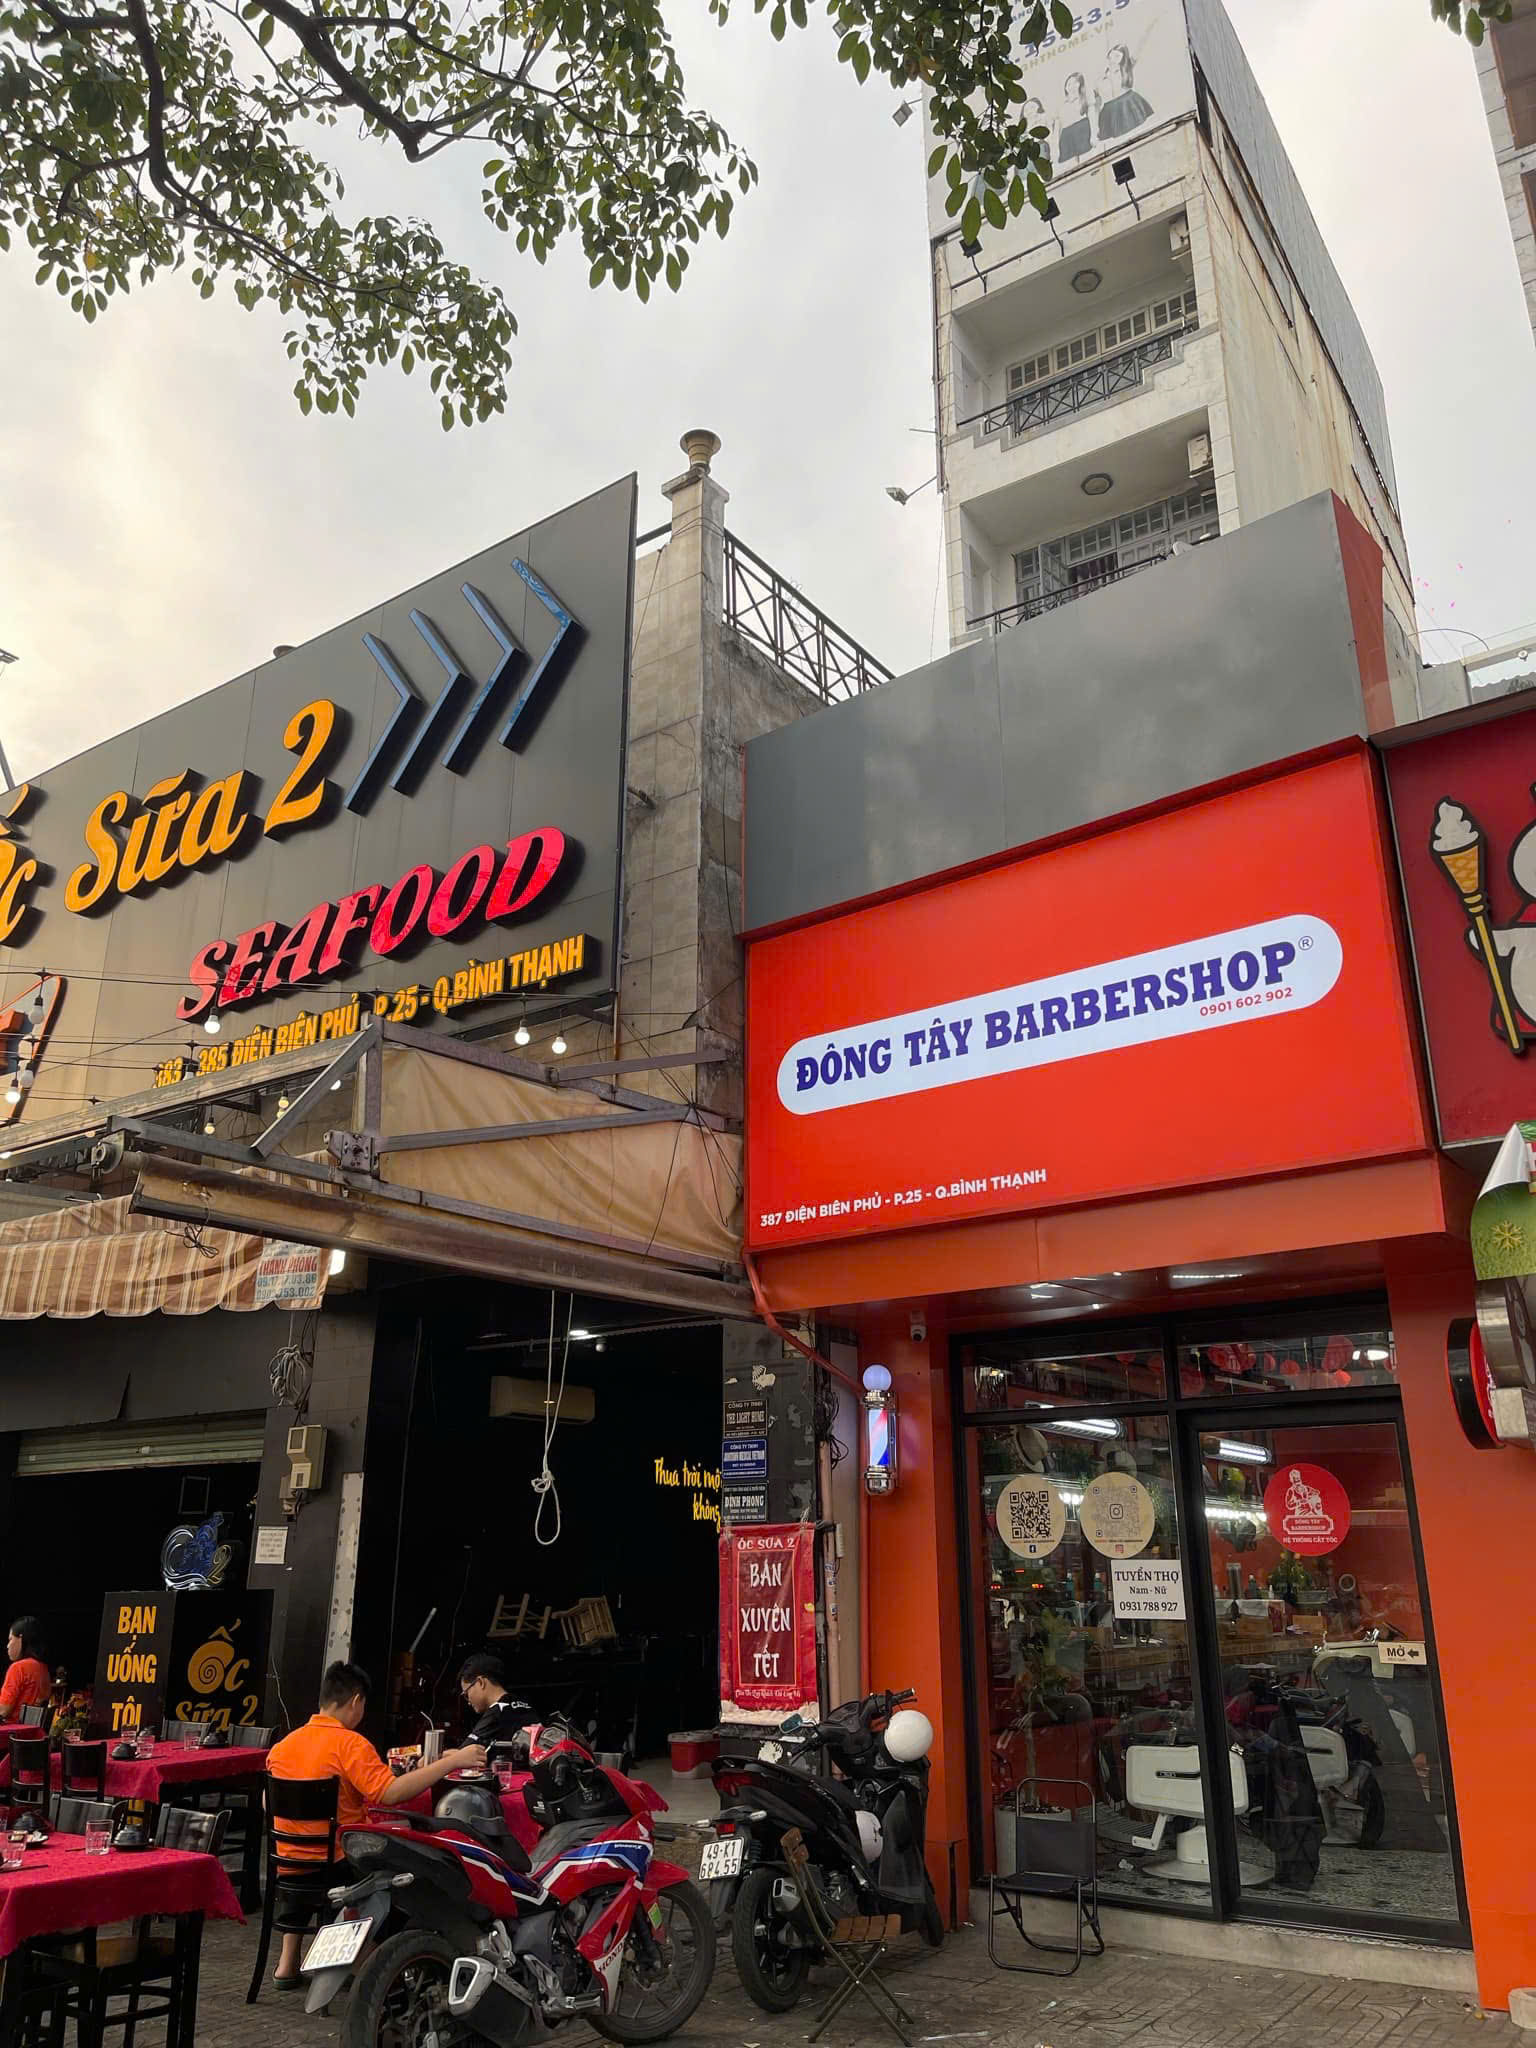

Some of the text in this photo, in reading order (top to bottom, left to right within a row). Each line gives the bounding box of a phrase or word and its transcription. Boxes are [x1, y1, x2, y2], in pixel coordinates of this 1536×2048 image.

[65, 768, 248, 912] Sữa
[264, 699, 335, 839] 2
[176, 826, 566, 1019] SEAFOOD
[274, 1011, 318, 1055] BIÊN
[320, 992, 360, 1040] PHỦ
[433, 957, 505, 1016] Q.BÌNH
[508, 933, 585, 988] THẠNH
[1200, 987, 1293, 1016] 0901 602 902
[796, 1038, 892, 1092] ĐÔNG
[904, 1018, 973, 1067] TÂY
[760, 1213, 783, 1227] 387
[784, 1206, 817, 1223] ĐIỆN
[819, 1199, 851, 1217] BIÊN
[853, 1192, 882, 1213] PHỦ
[894, 1189, 922, 1206] P.25
[935, 1177, 988, 1200] Q.BÌNH
[990, 1168, 1047, 1190] THẠNH
[703, 1468, 722, 1493] mộ
[787, 1537, 796, 1548] 2
[1115, 1567, 1152, 1581] TUYỂN
[1129, 1586, 1149, 1594] Nam
[117, 1605, 157, 1641] BẠN
[741, 1603, 791, 1632] XUYÊN
[1120, 1601, 1178, 1612] 0931 788 927
[106, 1641, 158, 1684] UỐNG
[753, 1644, 780, 1678] TẾT
[239, 1695, 258, 1727] 2
